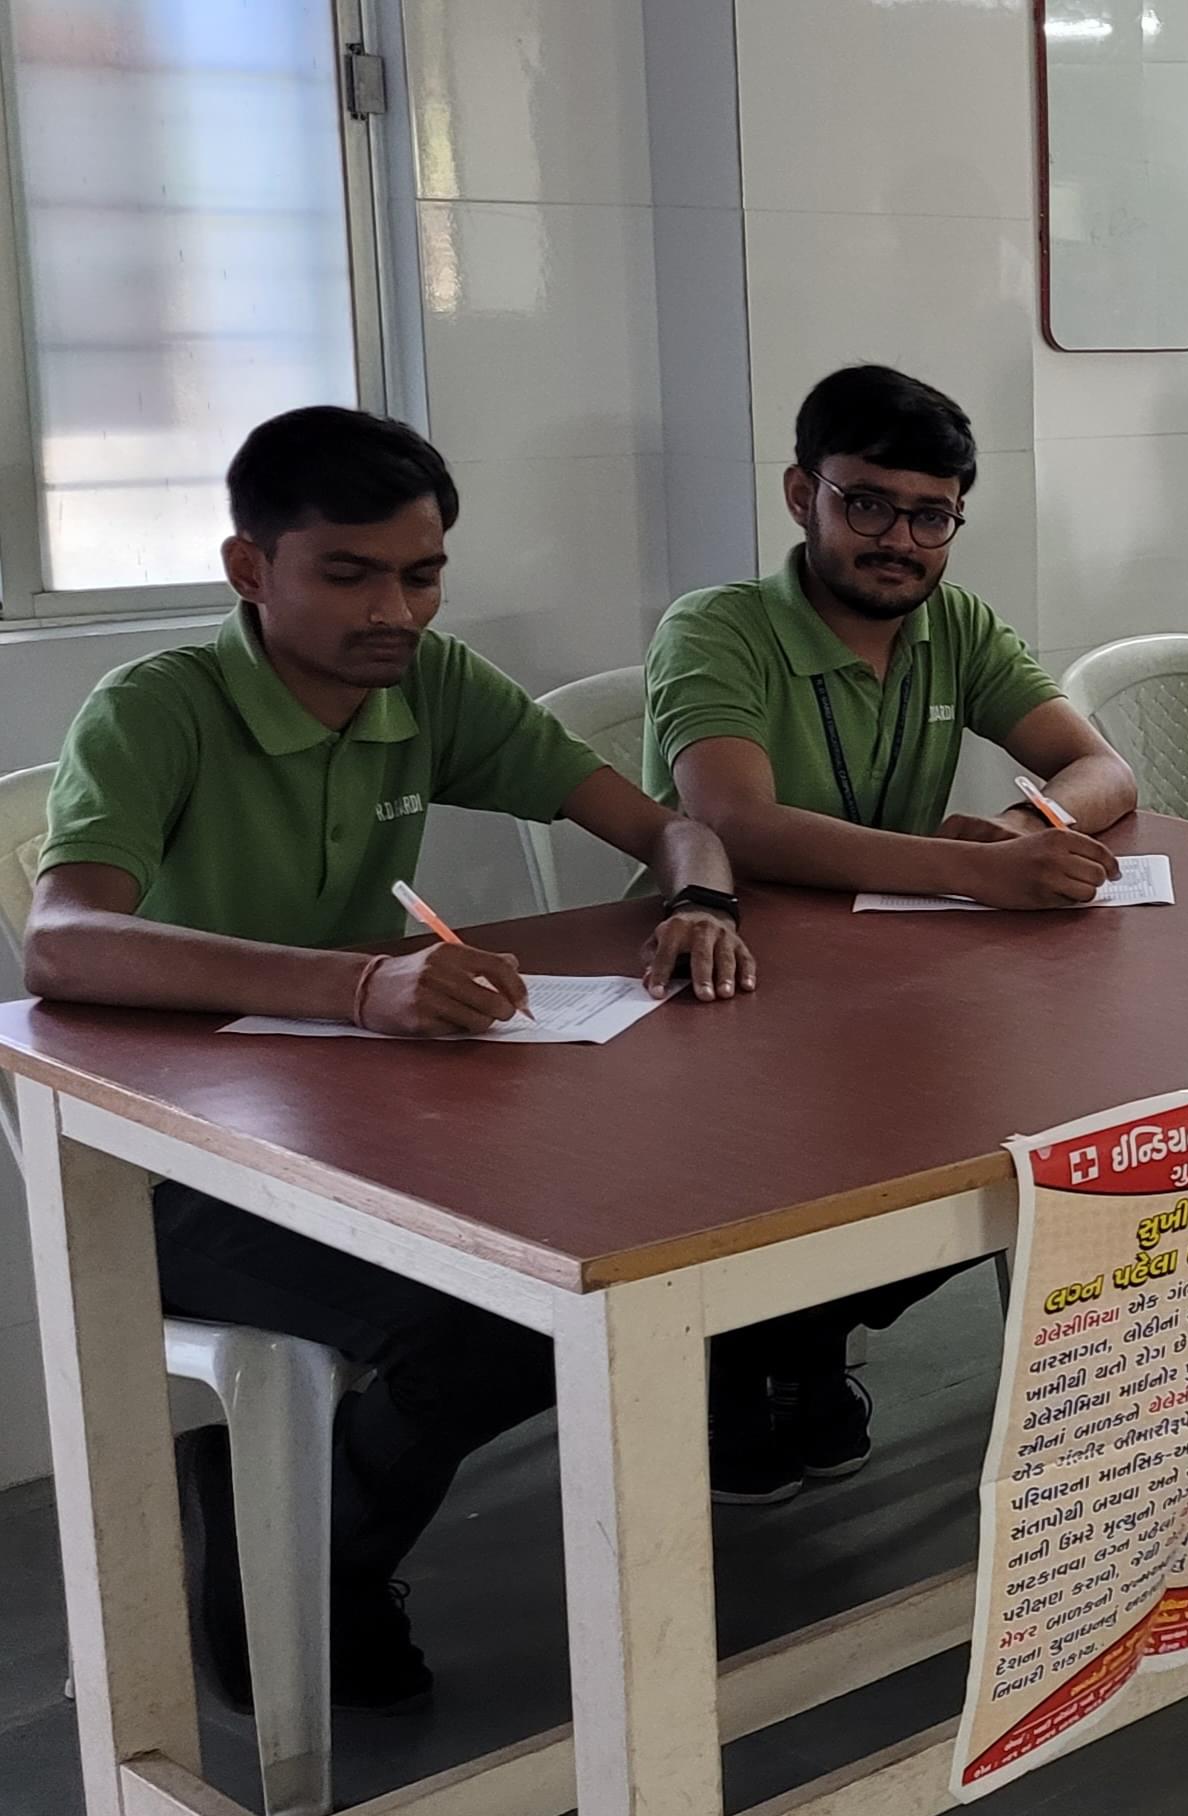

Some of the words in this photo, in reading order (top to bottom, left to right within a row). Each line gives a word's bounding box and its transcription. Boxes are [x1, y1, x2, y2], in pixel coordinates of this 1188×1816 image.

[1044, 1275, 1104, 1315] લગ્ન
[1034, 1308, 1119, 1345] થેલેસીમિયા
[1128, 1294, 1158, 1313] એક
[1027, 1368, 1086, 1401] ખામીથી
[1095, 1355, 1126, 1378] થતો
[1136, 1346, 1165, 1365] રોગ
[1174, 1334, 1186, 1352] છે
[1030, 1339, 1112, 1372] વારસાગત,
[1024, 1392, 1110, 1429] થેલેસીમિયા
[1074, 1403, 1139, 1439] બાળકને
[1011, 1501, 1083, 1540] સંતાપોથી
[1093, 1487, 1139, 1512] બચવા
[1148, 1468, 1178, 1491] અને
[1012, 1476, 1089, 1510] પરિવારના
[1009, 1539, 1049, 1568] નાની
[1059, 1524, 1093, 1550] ઉંમરે
[1007, 1557, 1085, 1595] અટકાવવા
[1095, 1539, 1129, 1561] લગ્ન
[1004, 1591, 1063, 1621] પરીક્ષણ
[996, 1647, 1041, 1675] દેશના
[992, 1665, 1043, 1701] નિવારી
